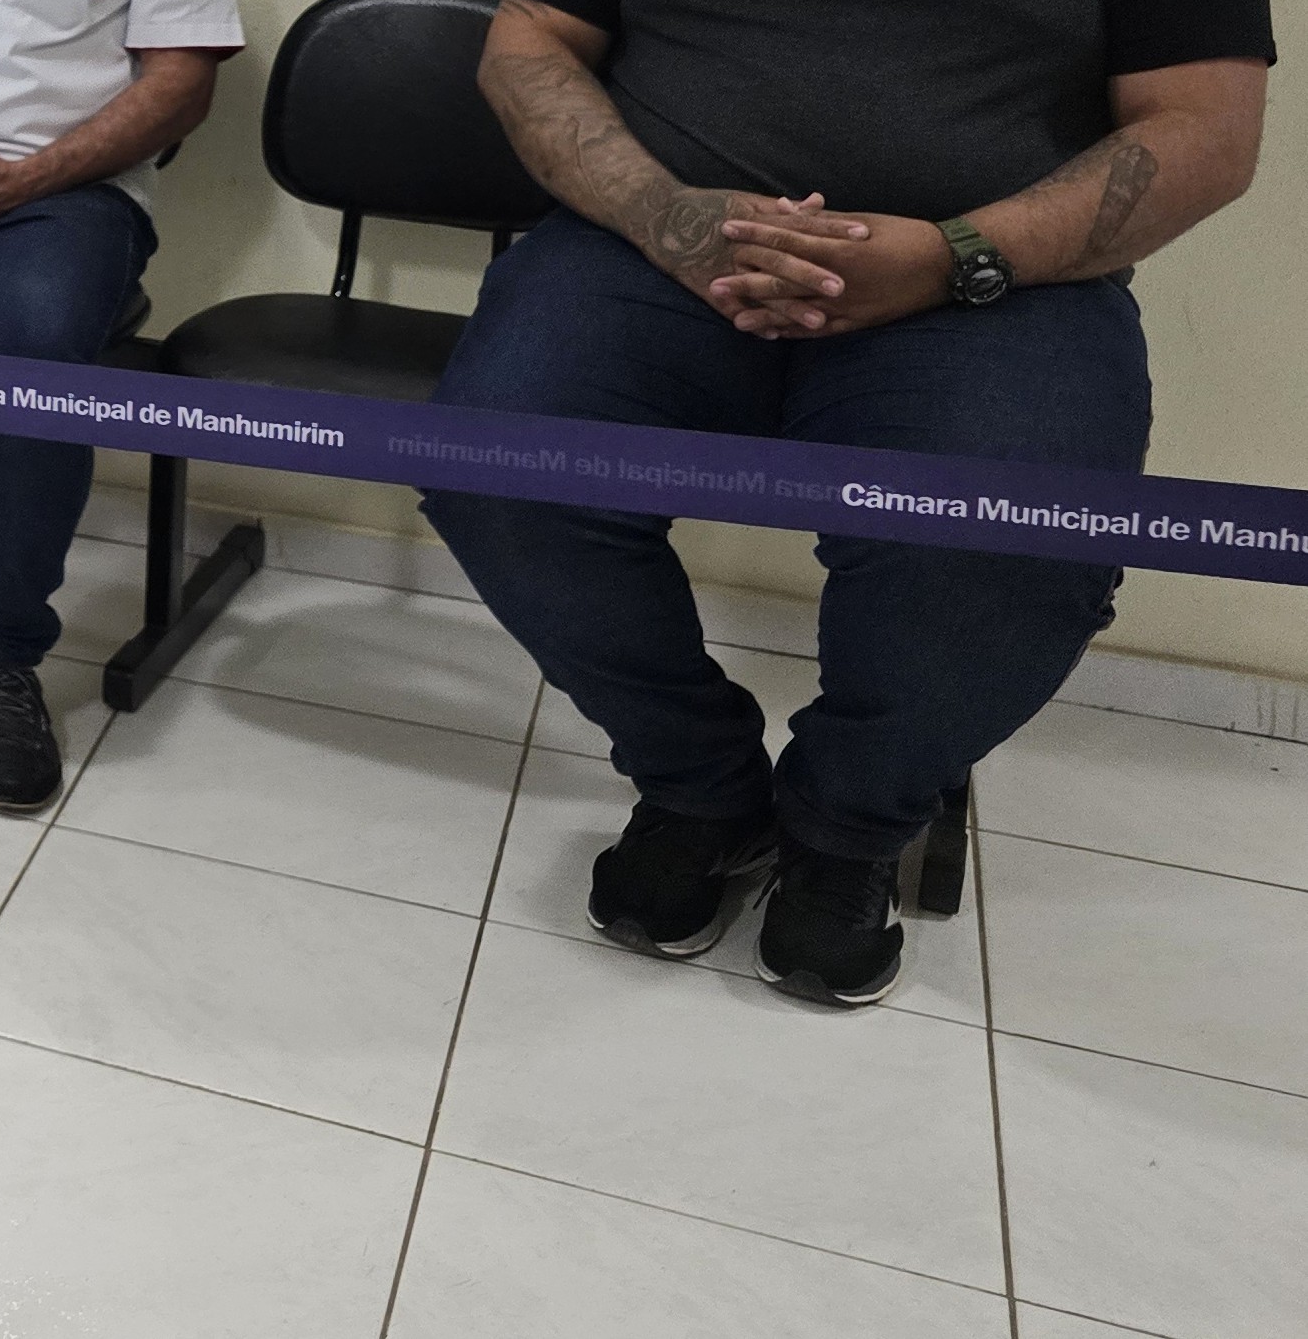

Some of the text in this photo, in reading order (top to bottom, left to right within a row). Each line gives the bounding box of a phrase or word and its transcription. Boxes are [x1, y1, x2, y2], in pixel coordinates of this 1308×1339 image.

[12, 386, 134, 425] Municipal
[138, 403, 172, 427] de
[176, 406, 345, 449] Manhumirim
[841, 483, 968, 519] Câmara
[977, 495, 1141, 540] Municipal
[1148, 515, 1191, 541] de
